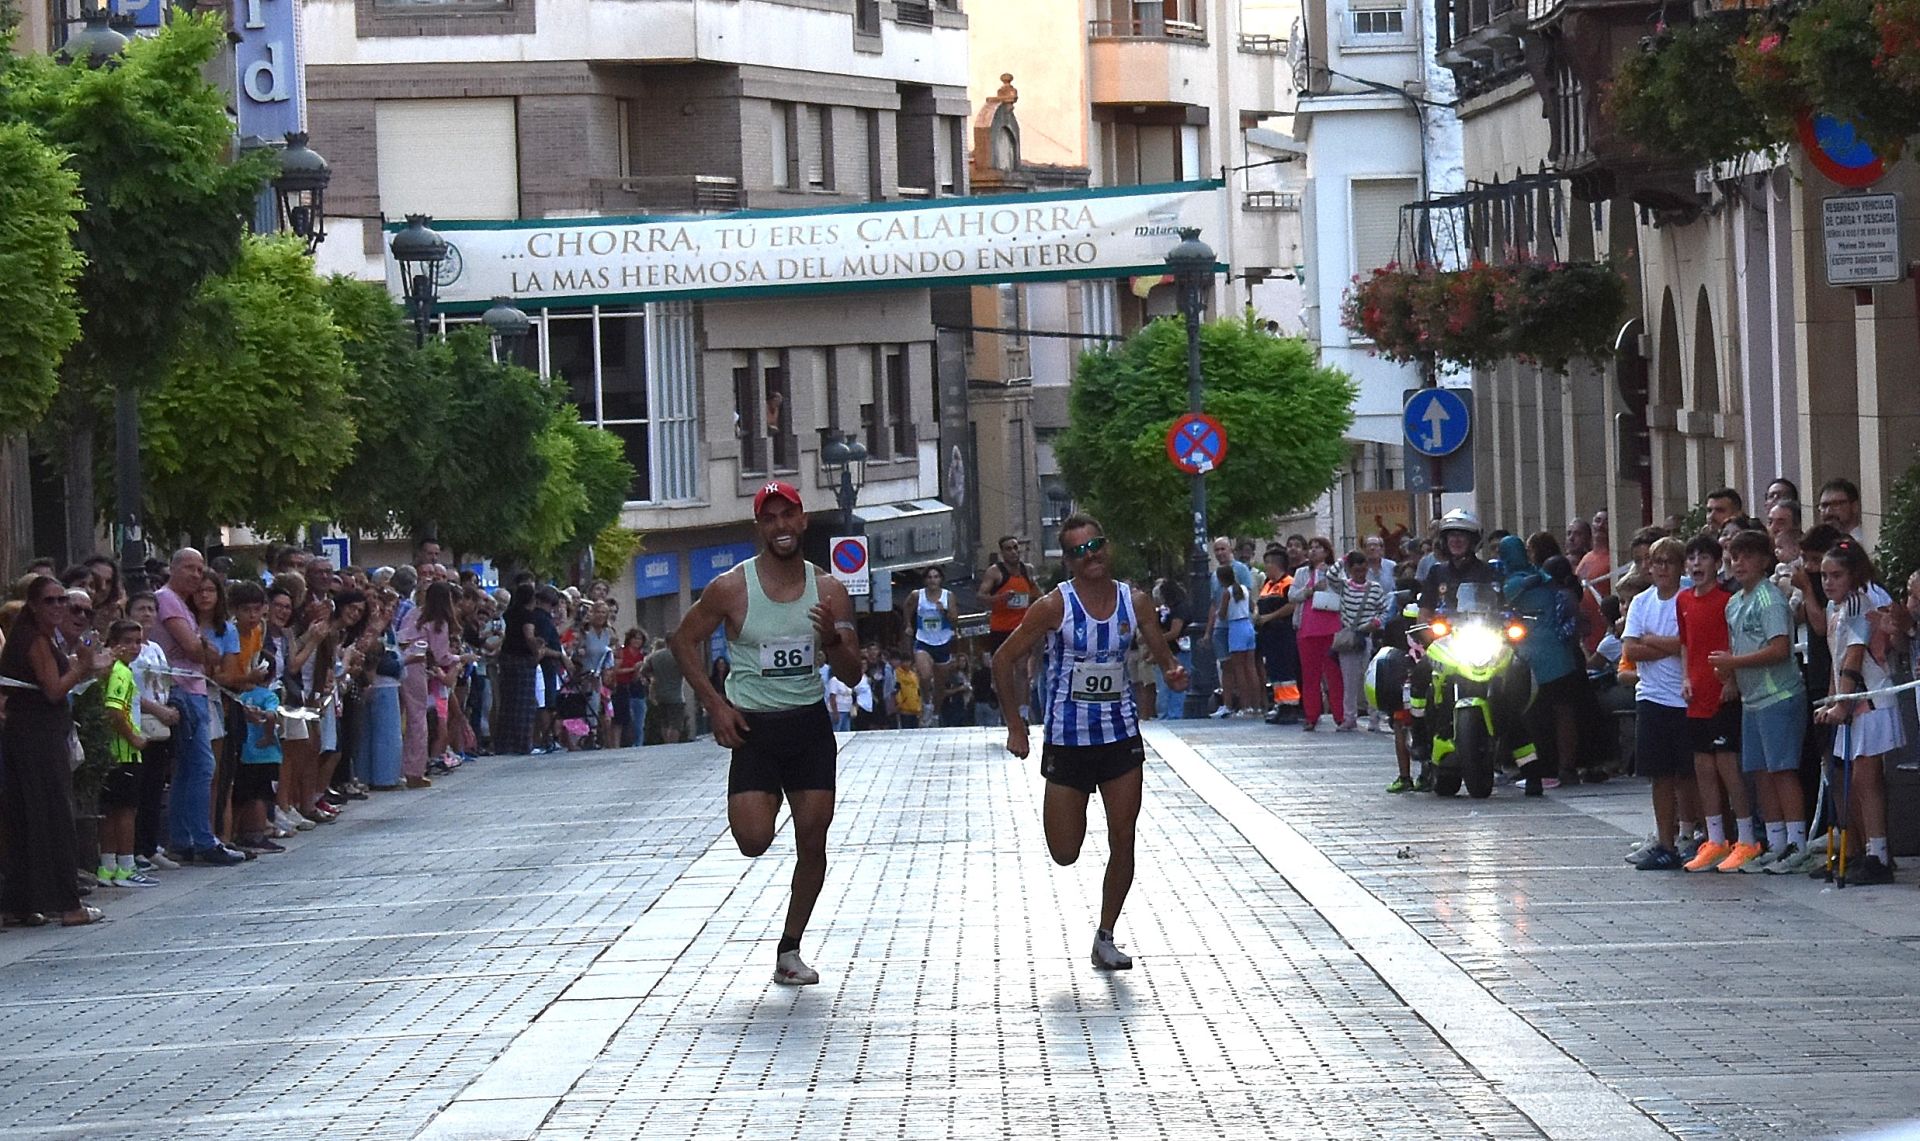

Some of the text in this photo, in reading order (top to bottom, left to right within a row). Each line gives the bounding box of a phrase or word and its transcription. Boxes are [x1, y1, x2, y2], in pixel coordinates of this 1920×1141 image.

[1826, 216, 1834, 226] DE
[1835, 215, 1855, 225] CARGA
[1863, 213, 1895, 224] DESCARGA
[502, 205, 1100, 259] ...CHORRA, TÚ ERES CALAHORRA
[511, 242, 1098, 293] LA MAS HERMOSA DEL MUNDO ENTERO
[773, 649, 803, 667] 86
[1085, 675, 1113, 692] 90
